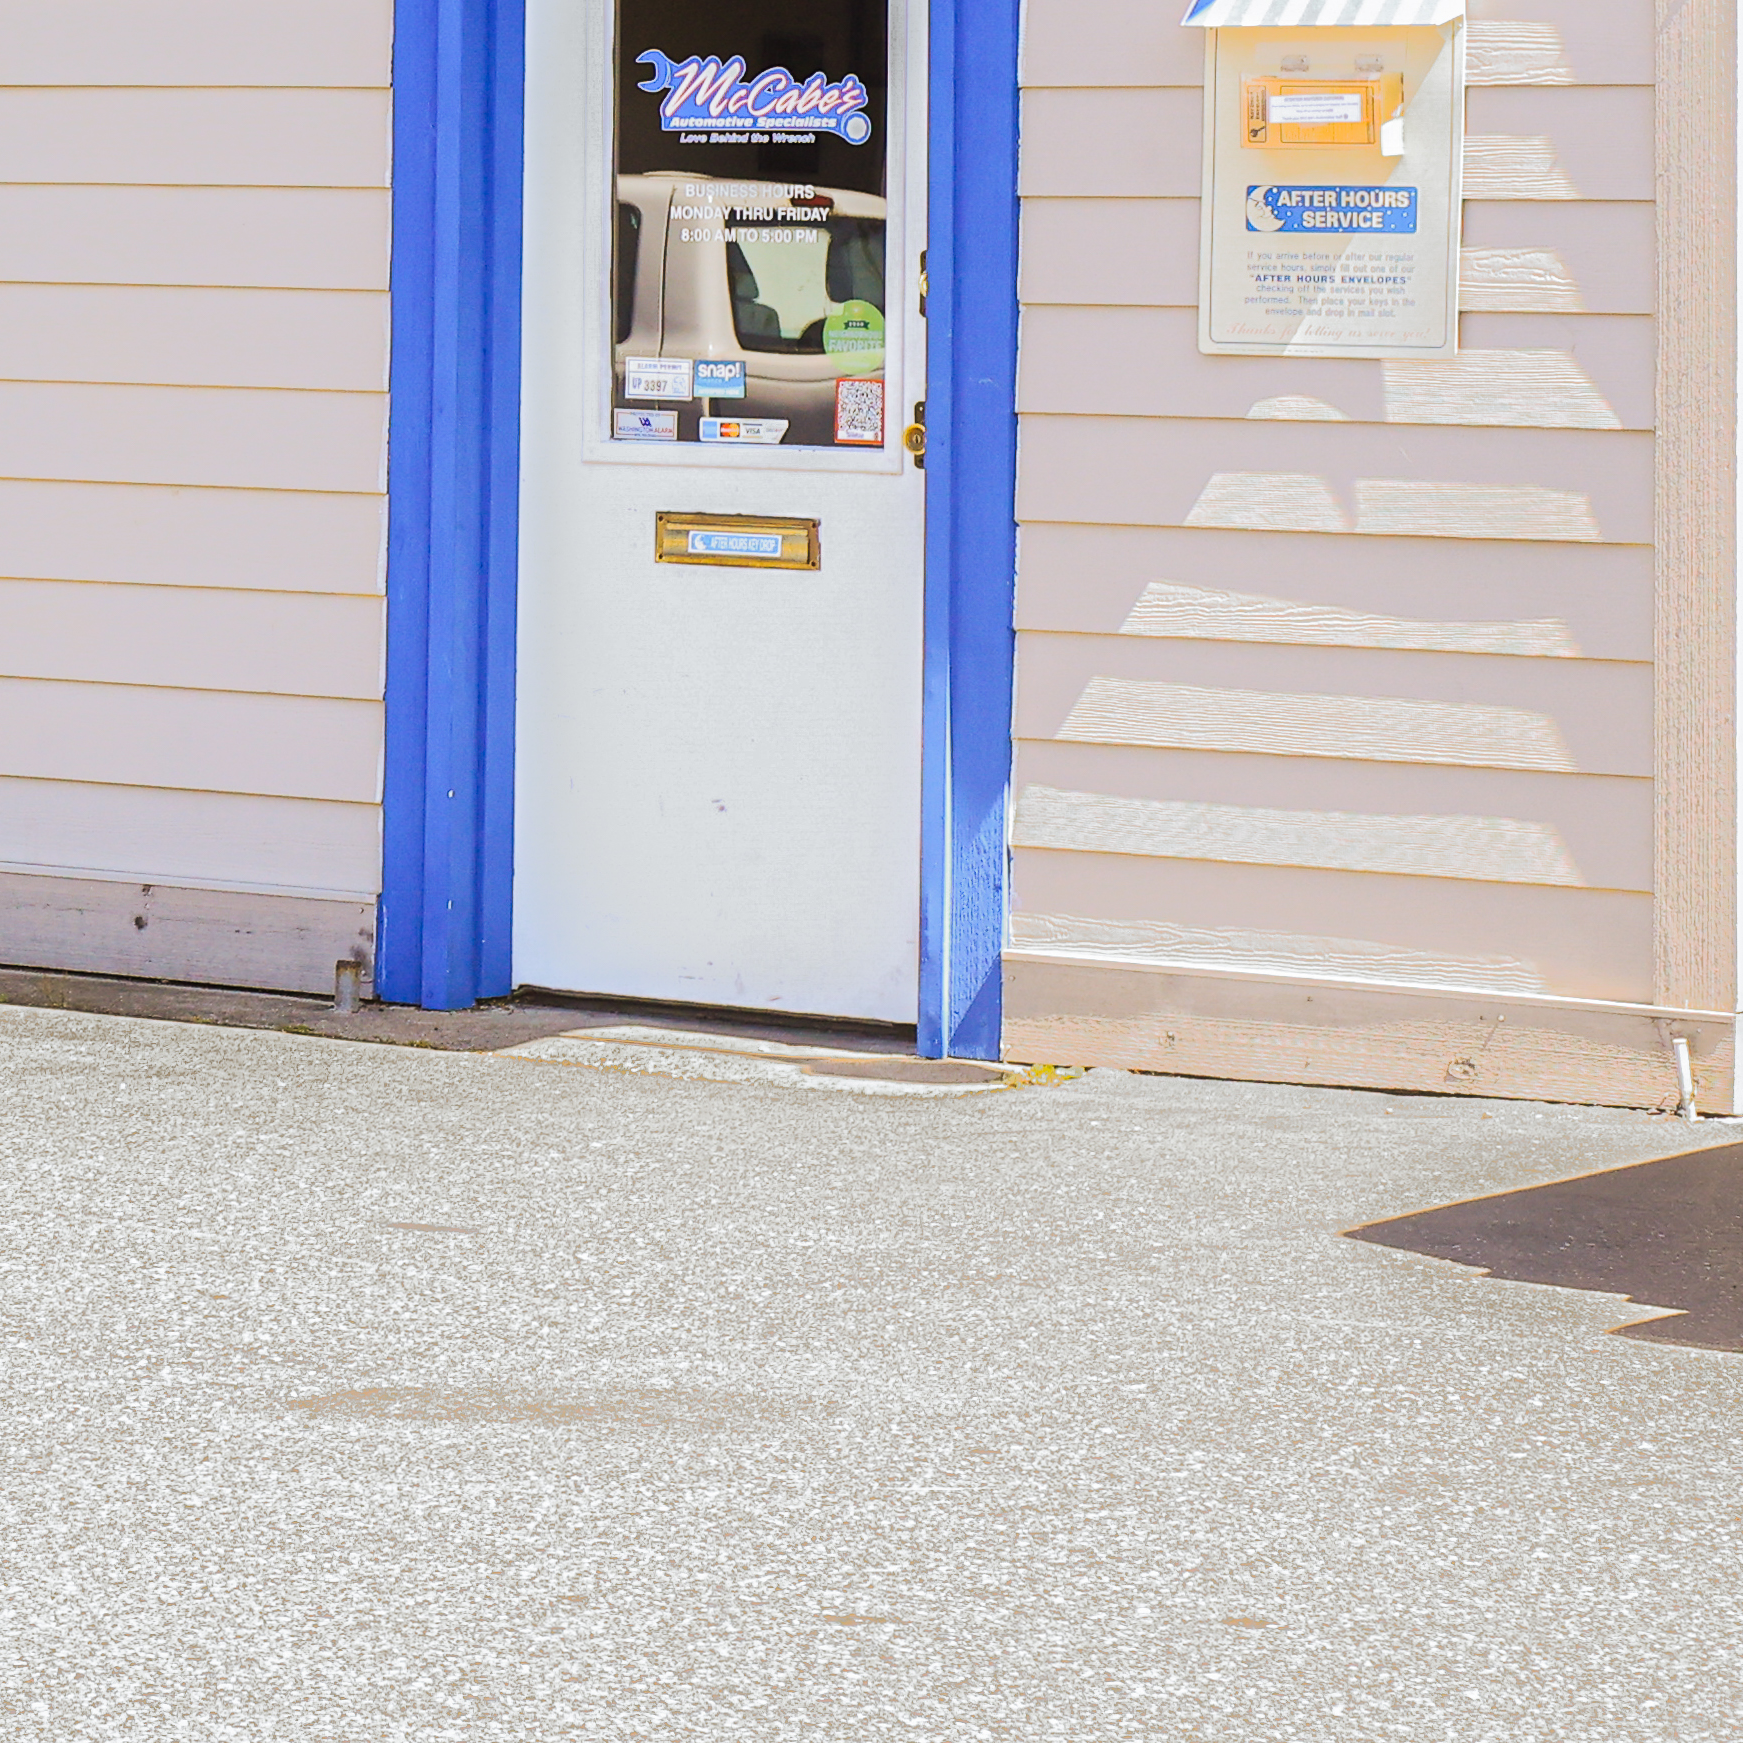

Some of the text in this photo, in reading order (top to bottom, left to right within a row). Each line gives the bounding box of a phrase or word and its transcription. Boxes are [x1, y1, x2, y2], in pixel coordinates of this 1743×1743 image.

[664, 61, 864, 118] McCabe's
[669, 116, 838, 129] Automotive Specialists
[679, 132, 816, 144] Love Behind the Wrench
[685, 184, 815, 199] BUSINESS HOURS
[1277, 190, 1410, 208] AFTER HOURS
[670, 206, 830, 222] MONDAY THRU FRIDAY
[1302, 210, 1384, 229] SERVICE
[681, 228, 818, 244] 8:00 AM TO 5:00 PM
[1296, 274, 1336, 284] HOURS
[697, 361, 741, 382] snap!
[643, 379, 668, 393] 3397
[745, 427, 761, 435] VISA
[711, 536, 728, 549] AFTER
[729, 537, 747, 550] HOURS
[760, 539, 776, 552] DROP
